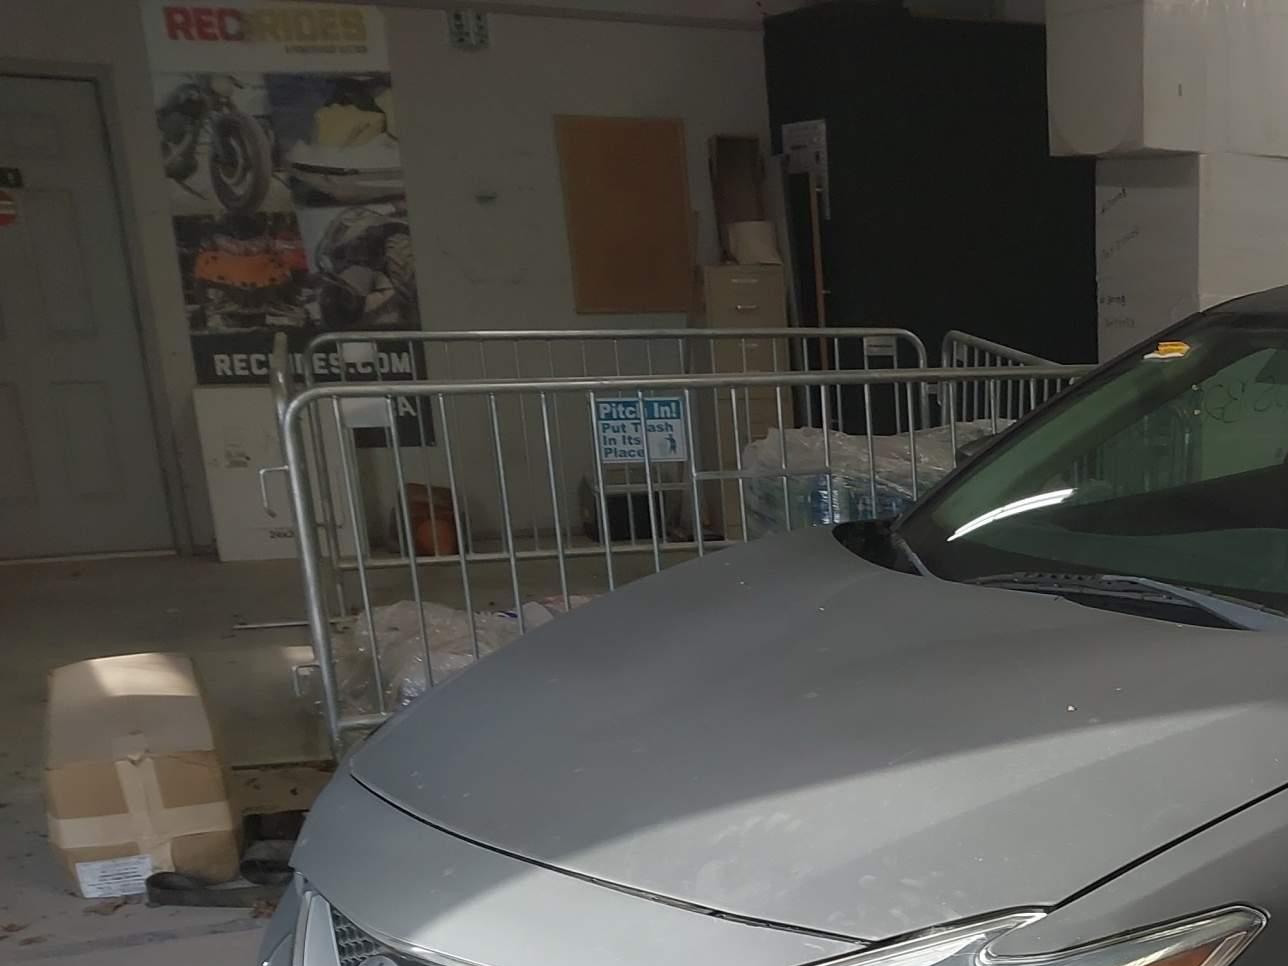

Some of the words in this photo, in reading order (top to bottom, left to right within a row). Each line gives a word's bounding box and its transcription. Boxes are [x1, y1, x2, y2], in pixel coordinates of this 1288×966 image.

[653, 402, 677, 418] In!
[601, 422, 627, 434] Put
[630, 421, 674, 433] Tash
[603, 435, 617, 446] In
[621, 434, 641, 446] Its
